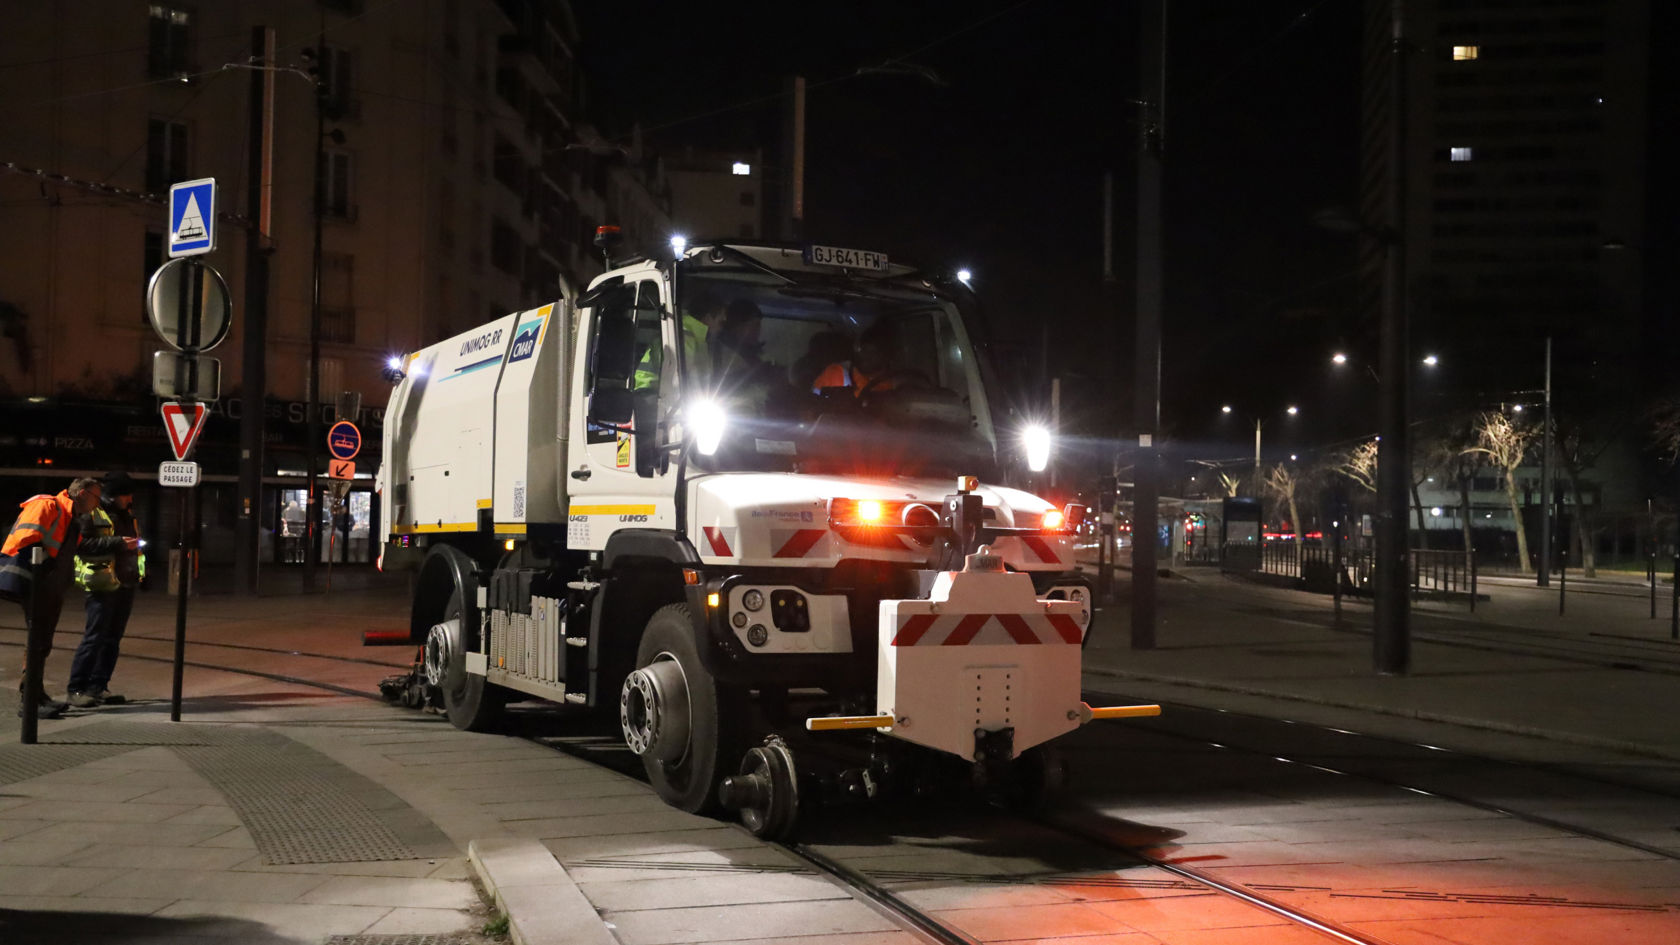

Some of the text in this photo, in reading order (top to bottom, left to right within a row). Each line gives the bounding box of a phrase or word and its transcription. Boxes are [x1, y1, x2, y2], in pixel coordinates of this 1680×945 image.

[815, 247, 880, 268] GJ-641-FW
[460, 328, 503, 357] UNIMOG RR
[513, 339, 533, 358] CMAR
[289, 402, 384, 429] SOTS
[55, 436, 94, 449] PIZZA
[163, 465, 184, 473] CÉDEZ
[163, 475, 192, 483] PASSAGE
[619, 514, 648, 522] UNIMOG
